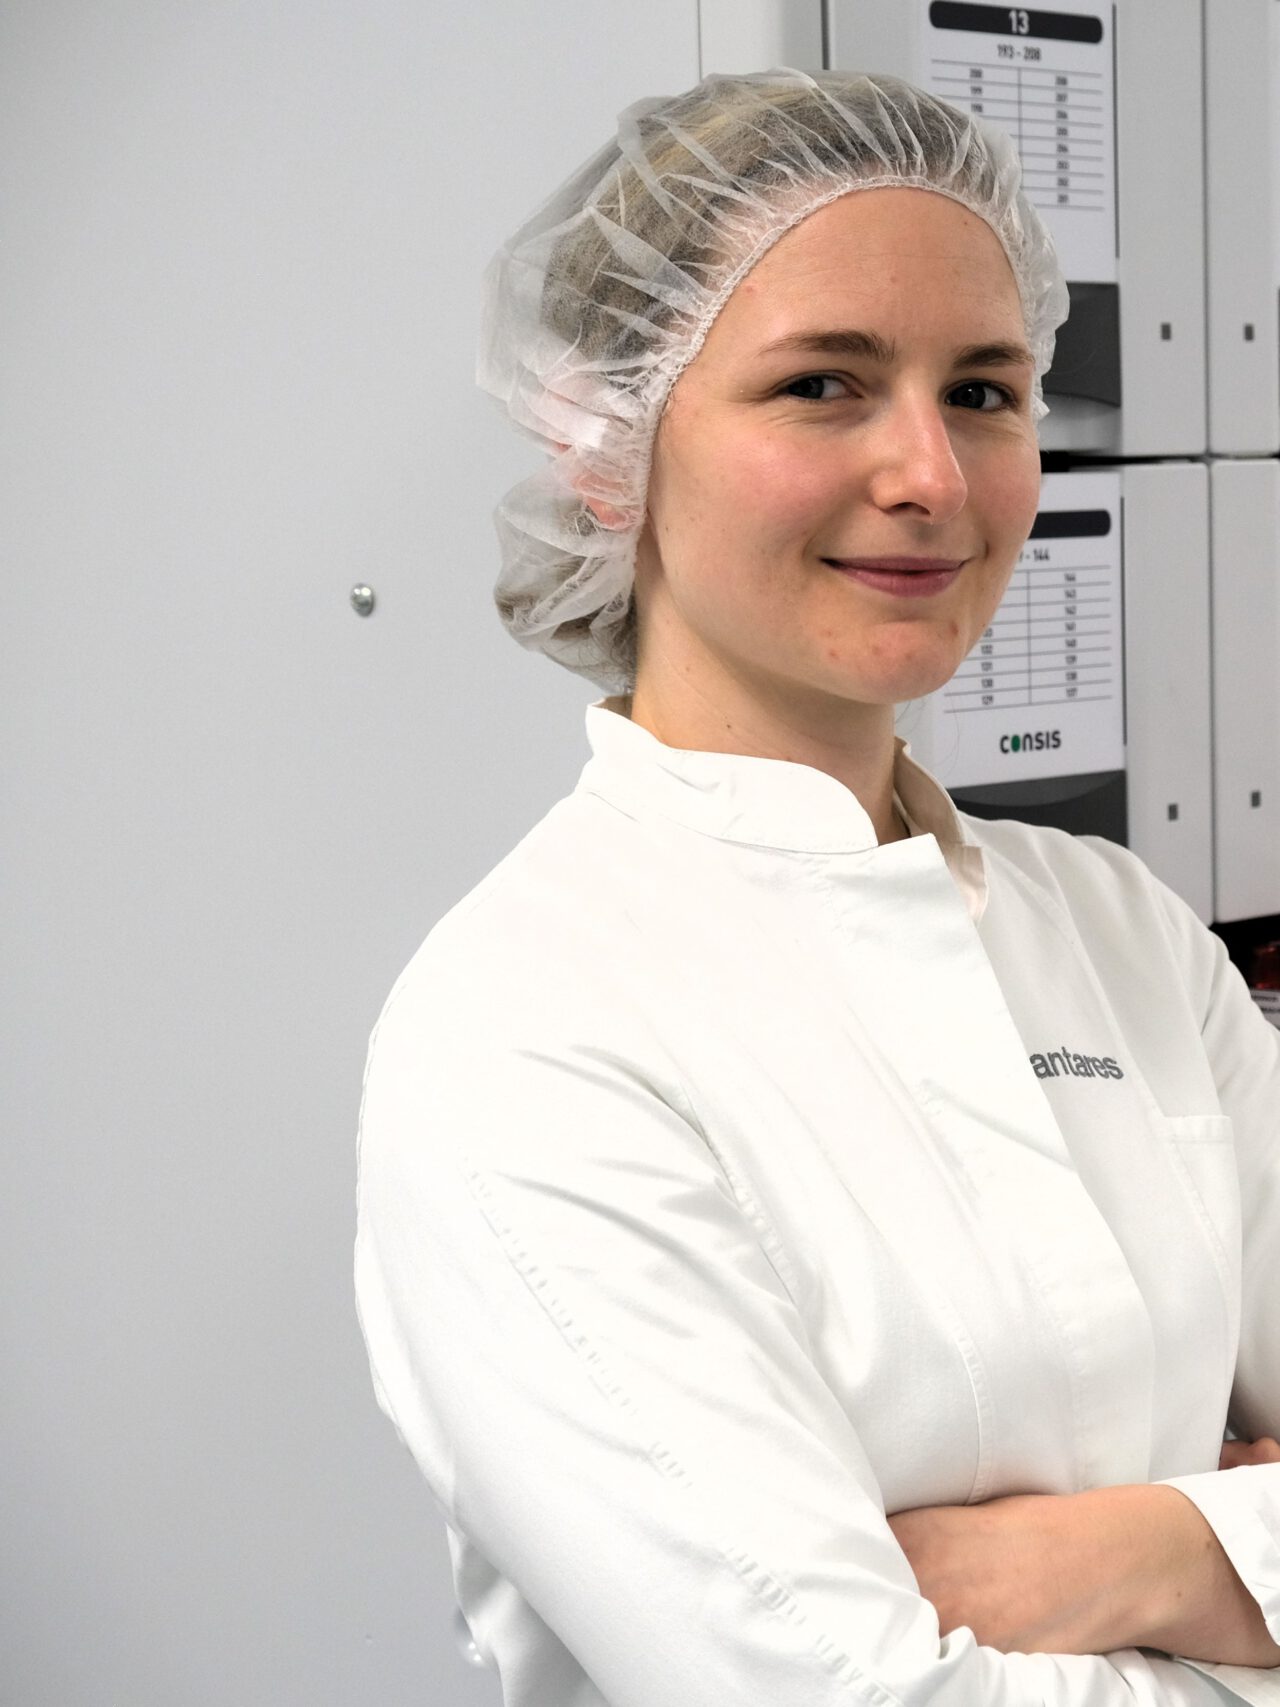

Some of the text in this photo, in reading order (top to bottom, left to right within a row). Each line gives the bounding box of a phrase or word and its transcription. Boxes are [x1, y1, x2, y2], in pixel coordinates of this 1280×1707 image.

[1009, 10, 1029, 34] 13
[997, 44, 1014, 59] 193
[1024, 47, 1041, 61] 208
[1033, 548, 1050, 560] 144
[1029, 1046, 1124, 1079] antares
